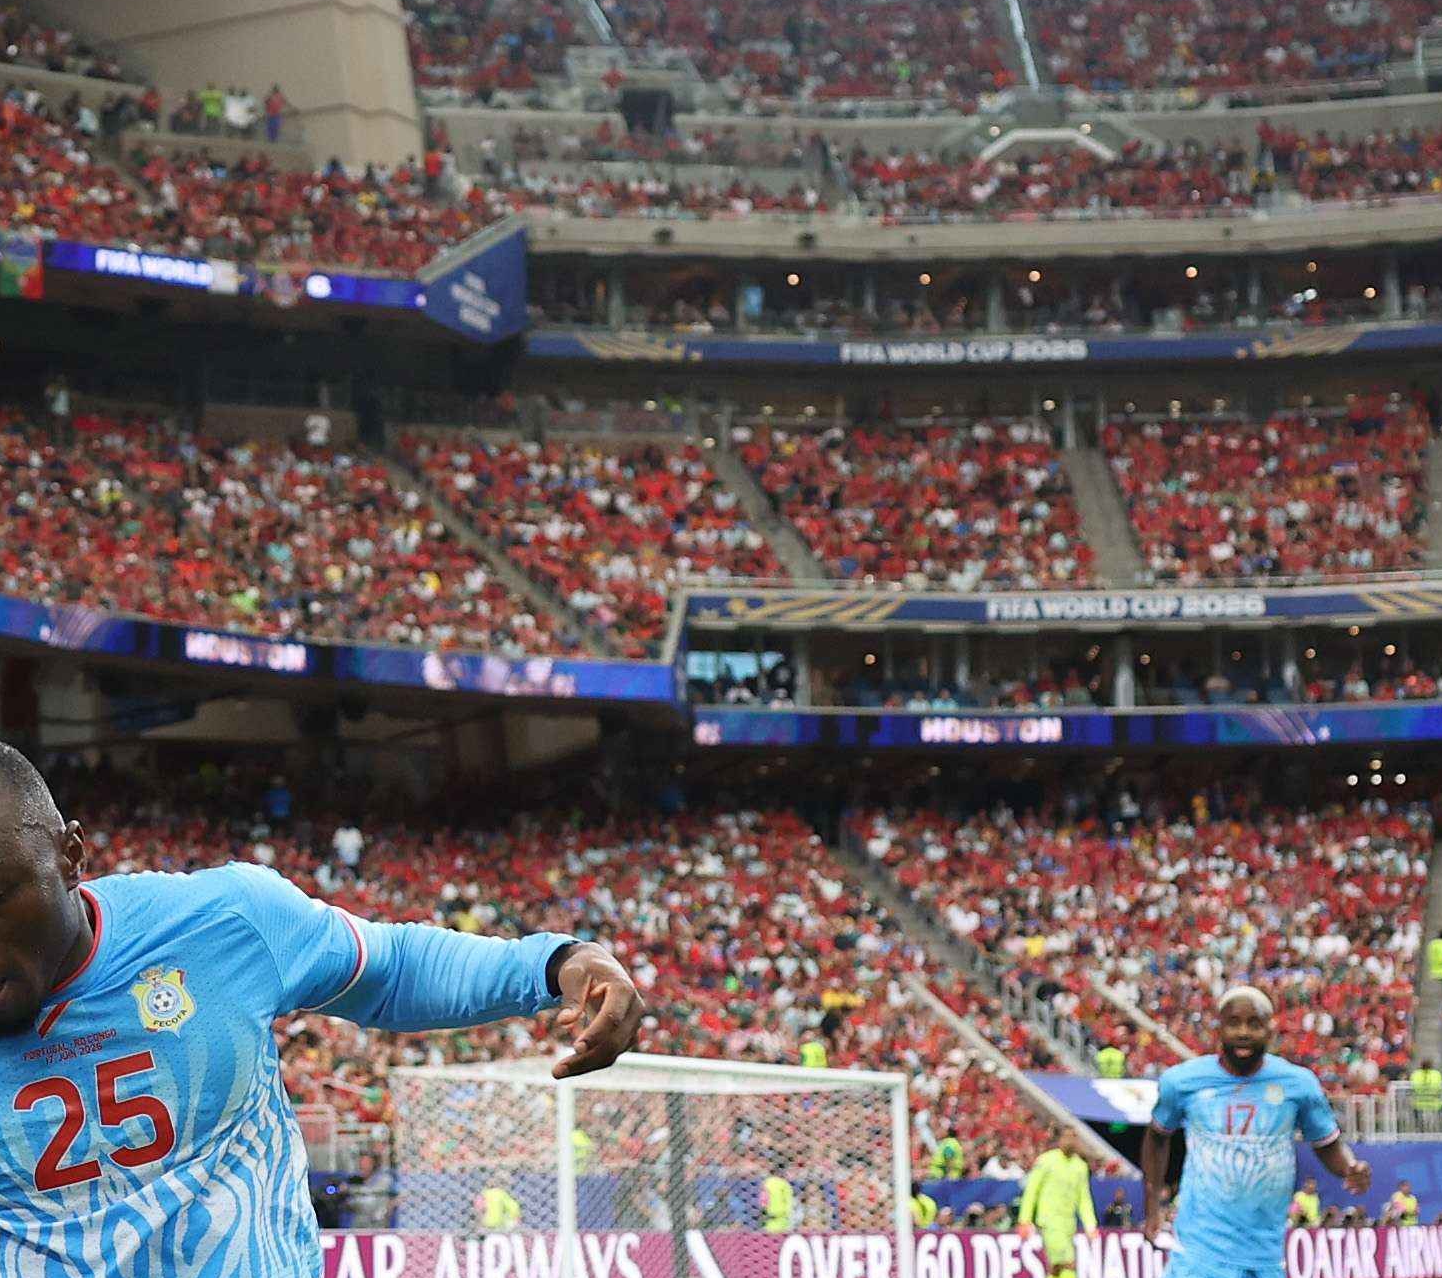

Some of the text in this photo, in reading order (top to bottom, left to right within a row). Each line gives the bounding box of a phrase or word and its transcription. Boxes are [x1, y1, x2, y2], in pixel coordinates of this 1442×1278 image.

[920, 717, 1063, 743] HOUSTON
[153, 1009, 188, 1028] FECOFA
[13, 1049, 177, 1193] 25
[1227, 1103, 1257, 1136] 17
